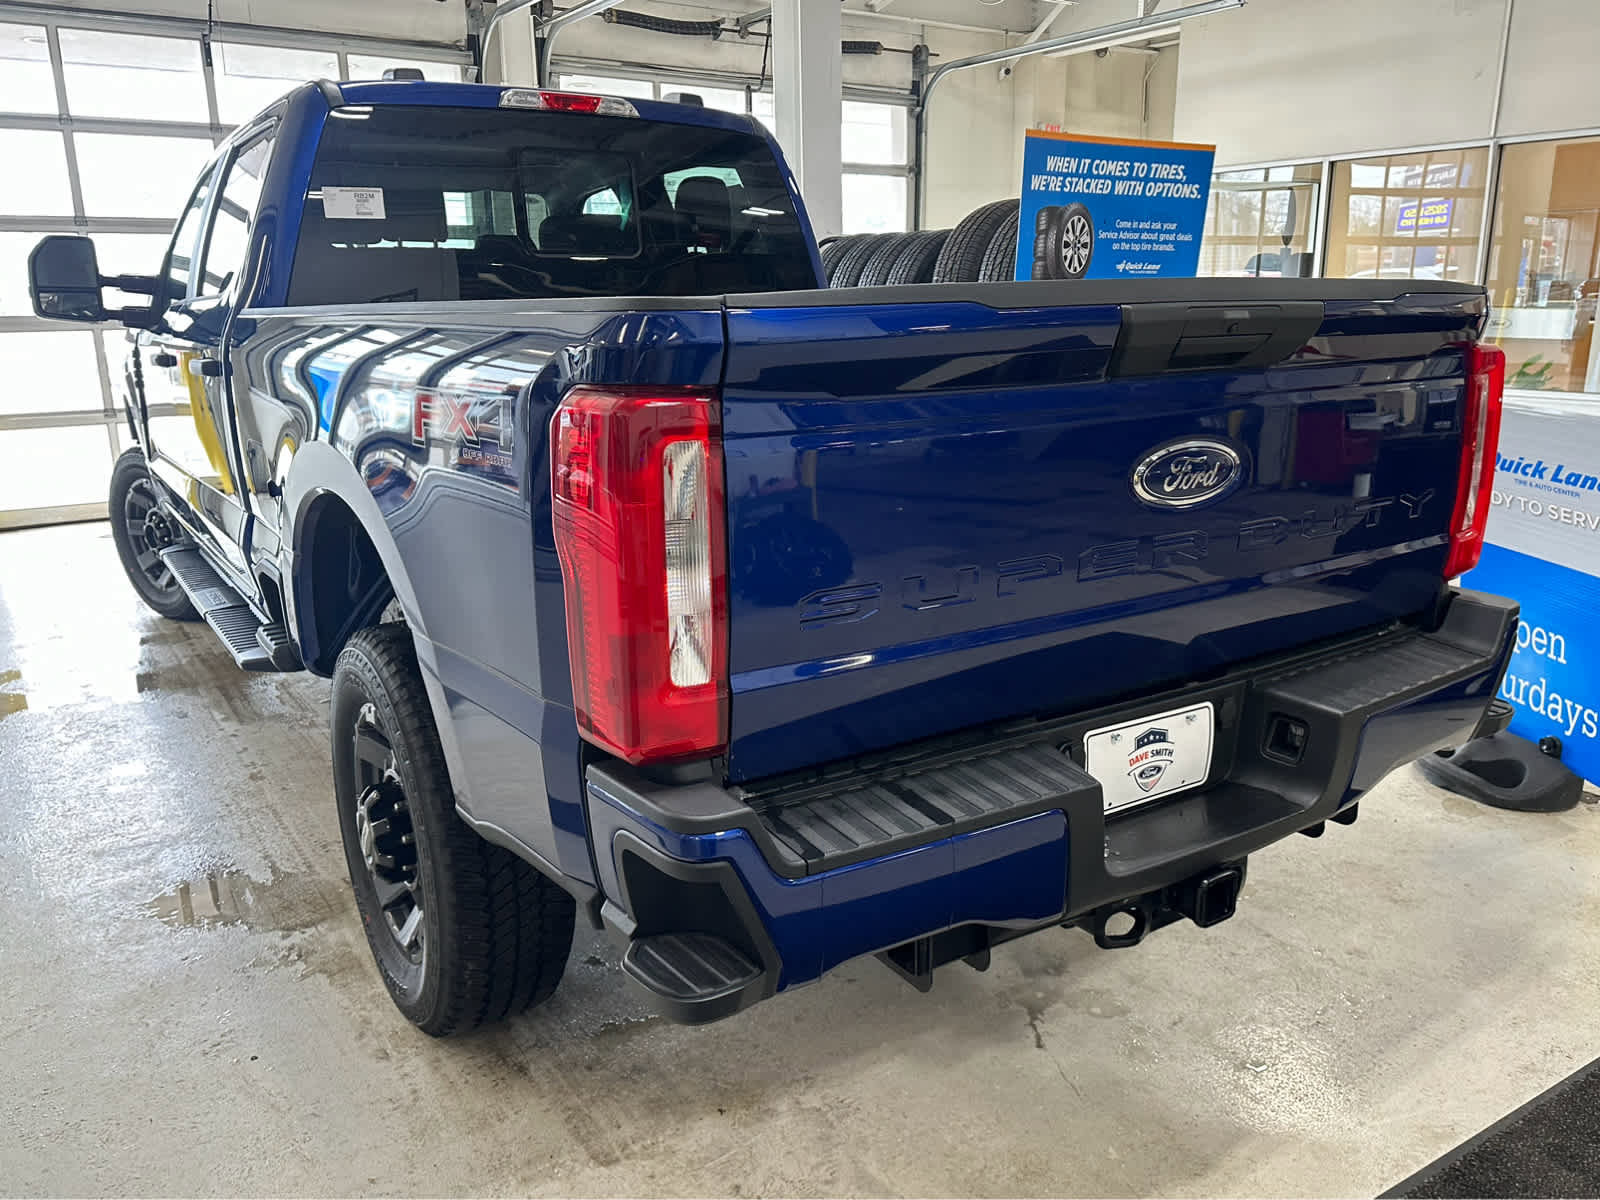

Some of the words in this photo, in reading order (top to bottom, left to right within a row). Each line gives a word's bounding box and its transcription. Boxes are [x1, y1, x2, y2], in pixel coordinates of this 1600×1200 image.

[1046, 155, 1078, 173] WHEN
[1079, 158, 1091, 174] IT
[1092, 160, 1130, 176] COMES
[1132, 161, 1147, 177] TO
[1149, 163, 1187, 182] TIRES,
[1031, 174, 1063, 192] WE'RE
[1063, 176, 1112, 194] STACKED
[1114, 180, 1144, 196] WITH
[1145, 181, 1201, 199] OPTIONS.
[1098, 229, 1118, 239] Service
[1118, 230, 1140, 239] Advisor
[1141, 231, 1158, 240] about
[1159, 233, 1176, 241] great
[1176, 232, 1193, 241] deals
[1115, 219, 1132, 228] Come
[1132, 219, 1139, 228] in
[1139, 220, 1150, 229] and
[1151, 221, 1161, 229] ask
[1162, 222, 1177, 231] your
[1112, 242, 1120, 250] on
[1120, 242, 1130, 250] the
[1131, 242, 1141, 252] top
[1141, 242, 1152, 250] tire
[1125, 262, 1143, 270] Quick
[1143, 262, 1161, 270] Lane
[411, 390, 514, 455] FX4
[1163, 455, 1221, 493] Ford
[1534, 483, 1552, 492] AUTO
[1553, 487, 1580, 498] CENTER
[1517, 496, 1542, 515] TO
[1548, 504, 1600, 530] SERV
[798, 529, 1208, 632] SUPER
[1234, 488, 1436, 552] DUTY
[1502, 671, 1599, 738] urdays
[1129, 751, 1150, 767] DAVE
[1150, 748, 1174, 758] SMITH
